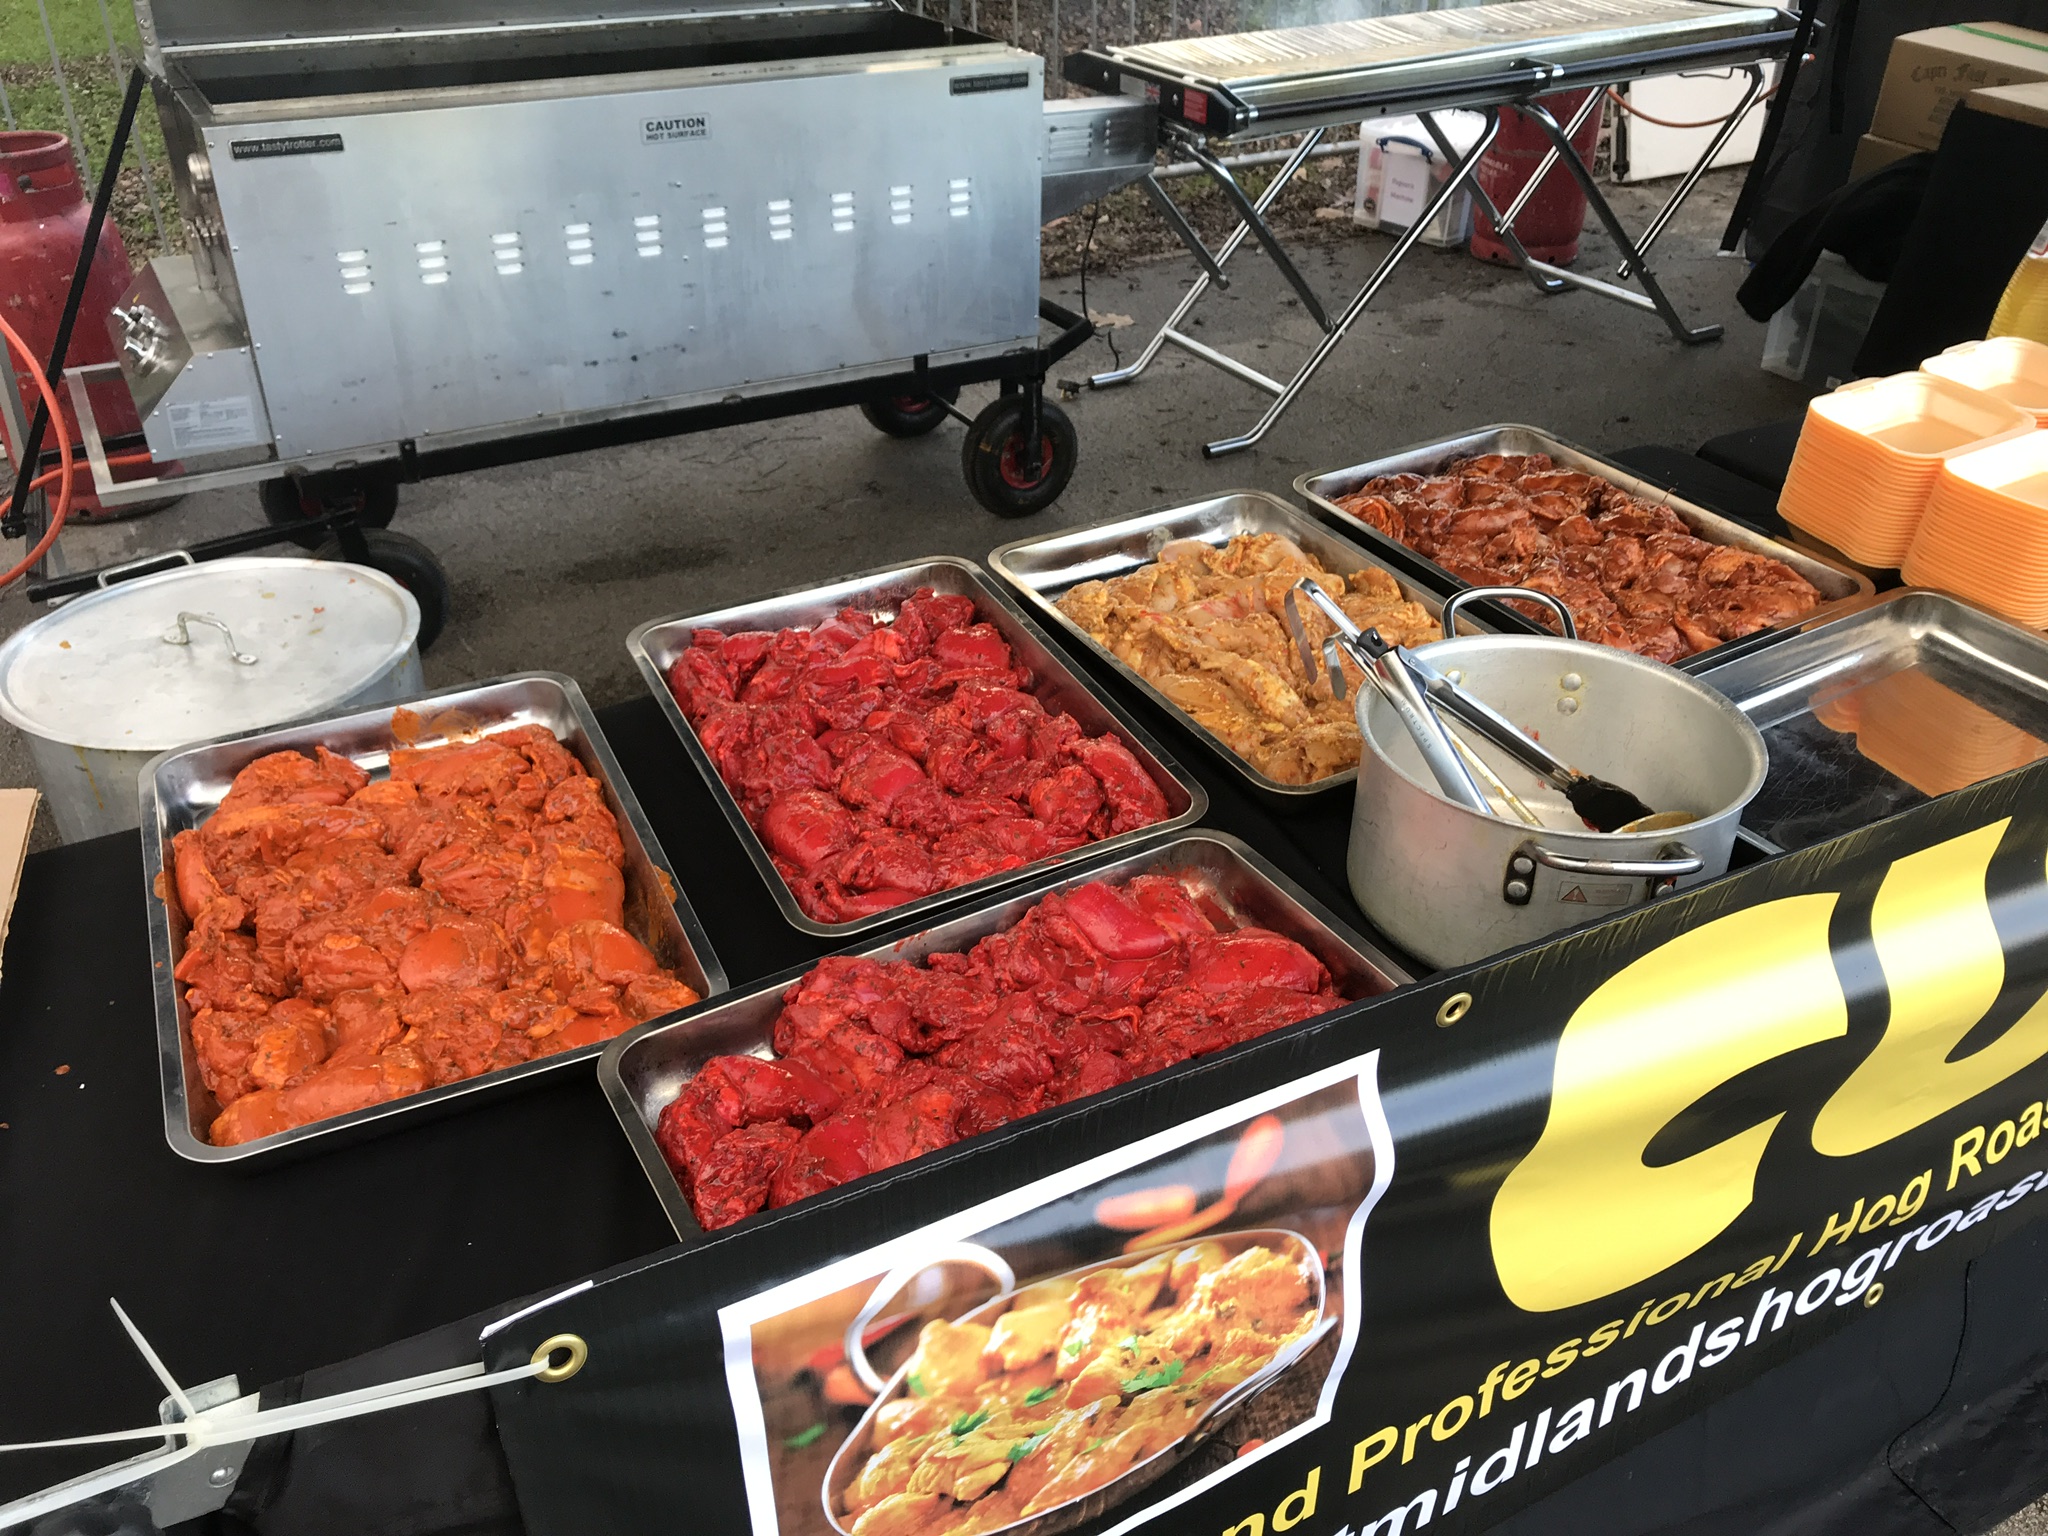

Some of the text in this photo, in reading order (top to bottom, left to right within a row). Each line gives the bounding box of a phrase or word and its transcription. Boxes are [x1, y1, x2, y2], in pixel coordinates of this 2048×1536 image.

[645, 117, 706, 132] CAUTION
[645, 128, 707, 141] HOT SURFACE
[233, 138, 341, 153] www.tastytrotter.com
[1348, 1232, 1804, 1494] Professional
[1806, 1168, 1933, 1258] Hog
[1946, 1099, 2048, 1192] Roa
